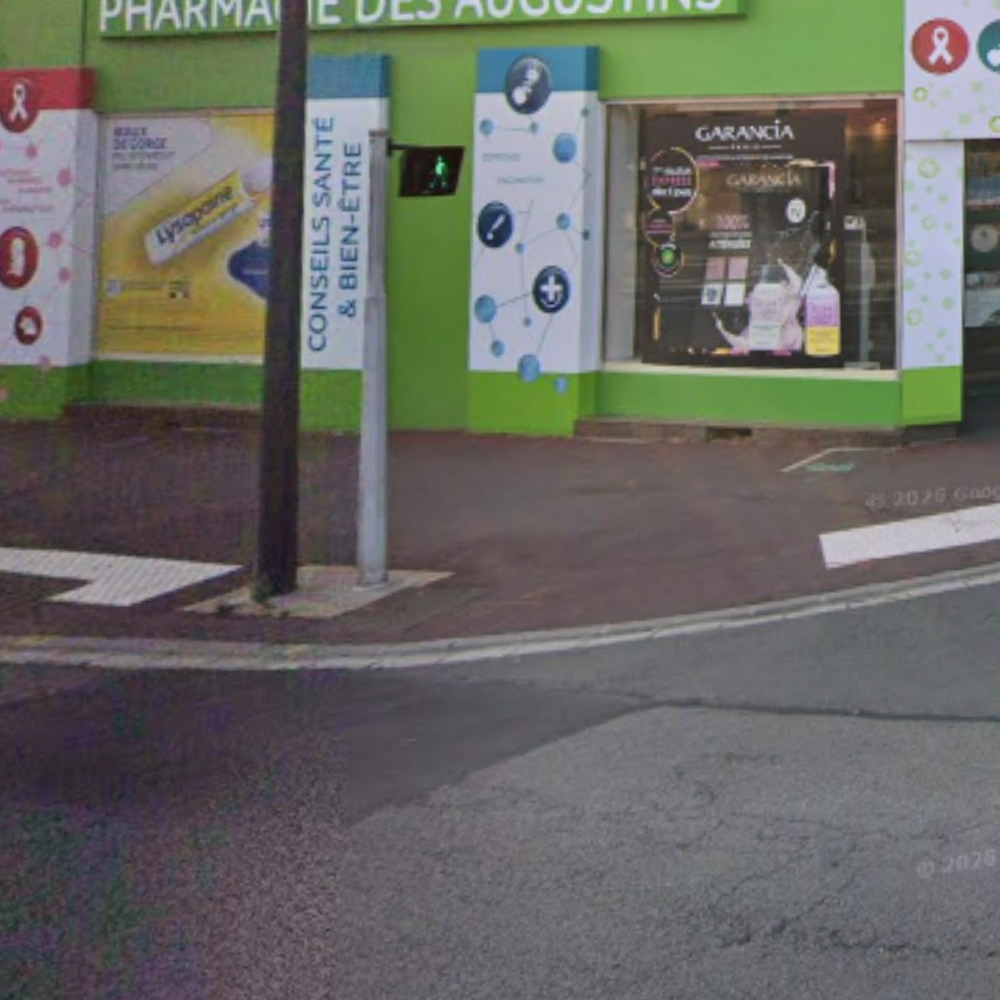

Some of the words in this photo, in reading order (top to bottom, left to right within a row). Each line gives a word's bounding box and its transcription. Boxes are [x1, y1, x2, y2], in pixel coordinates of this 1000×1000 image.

[311, 116, 334, 208] SANTÉ
[337, 142, 363, 290] BIEN-ÊTRE
[308, 214, 331, 352] CONSEILS
[338, 299, 357, 318] &
